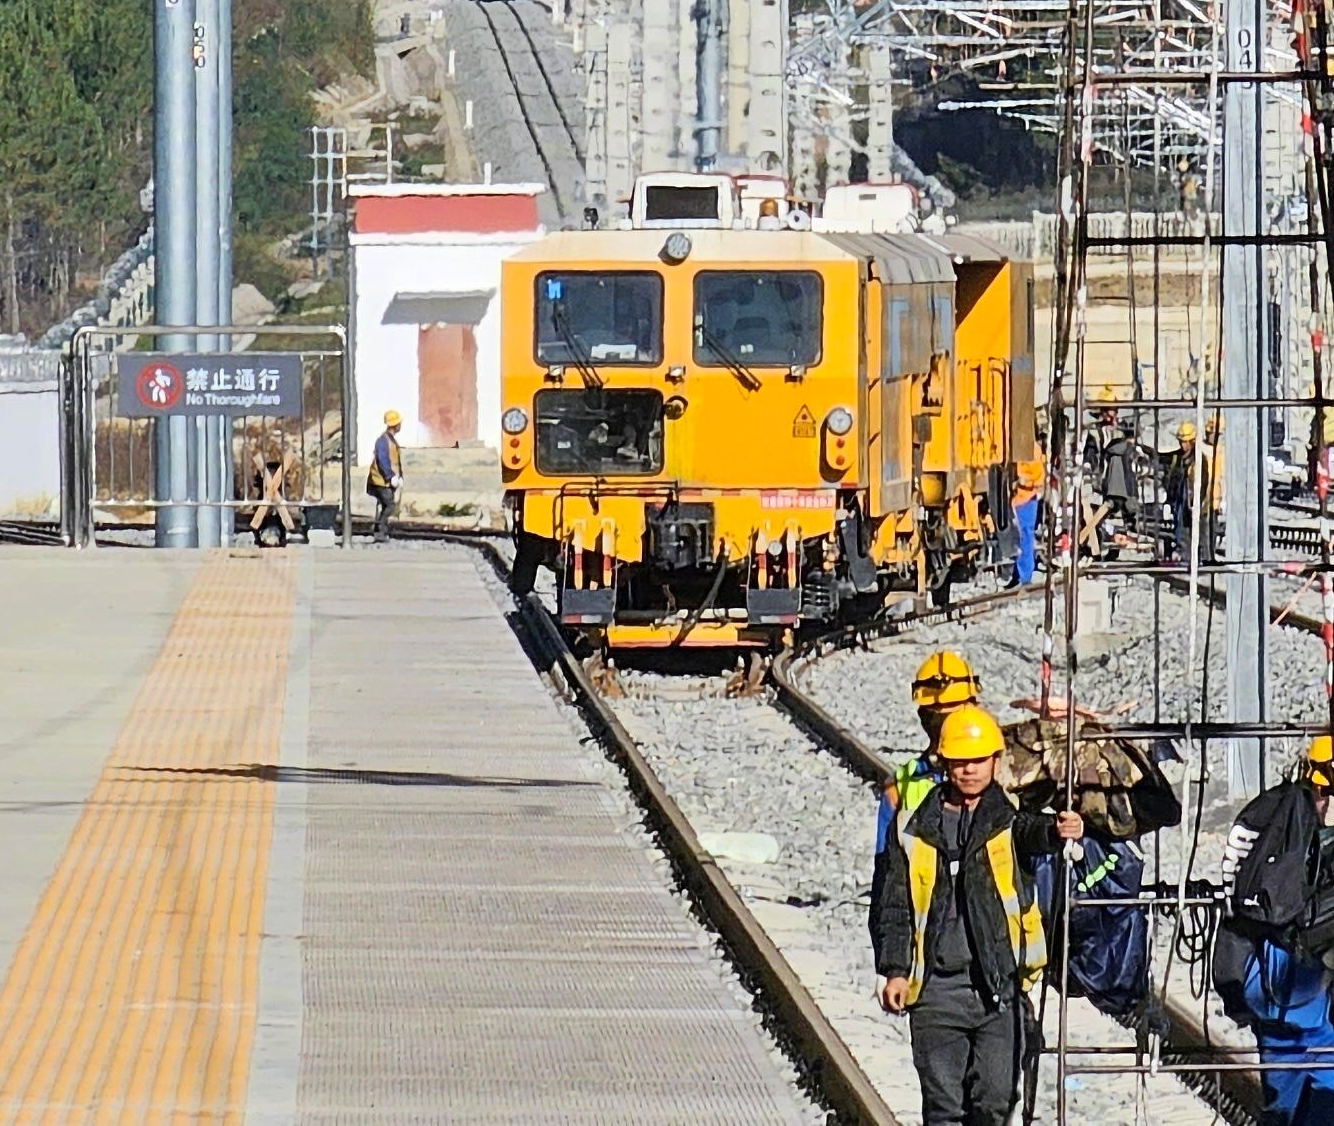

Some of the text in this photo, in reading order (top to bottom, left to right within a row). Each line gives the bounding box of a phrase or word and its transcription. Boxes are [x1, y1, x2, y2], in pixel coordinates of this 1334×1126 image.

[186, 367, 281, 392] 禁止通行
[186, 393, 204, 406] No
